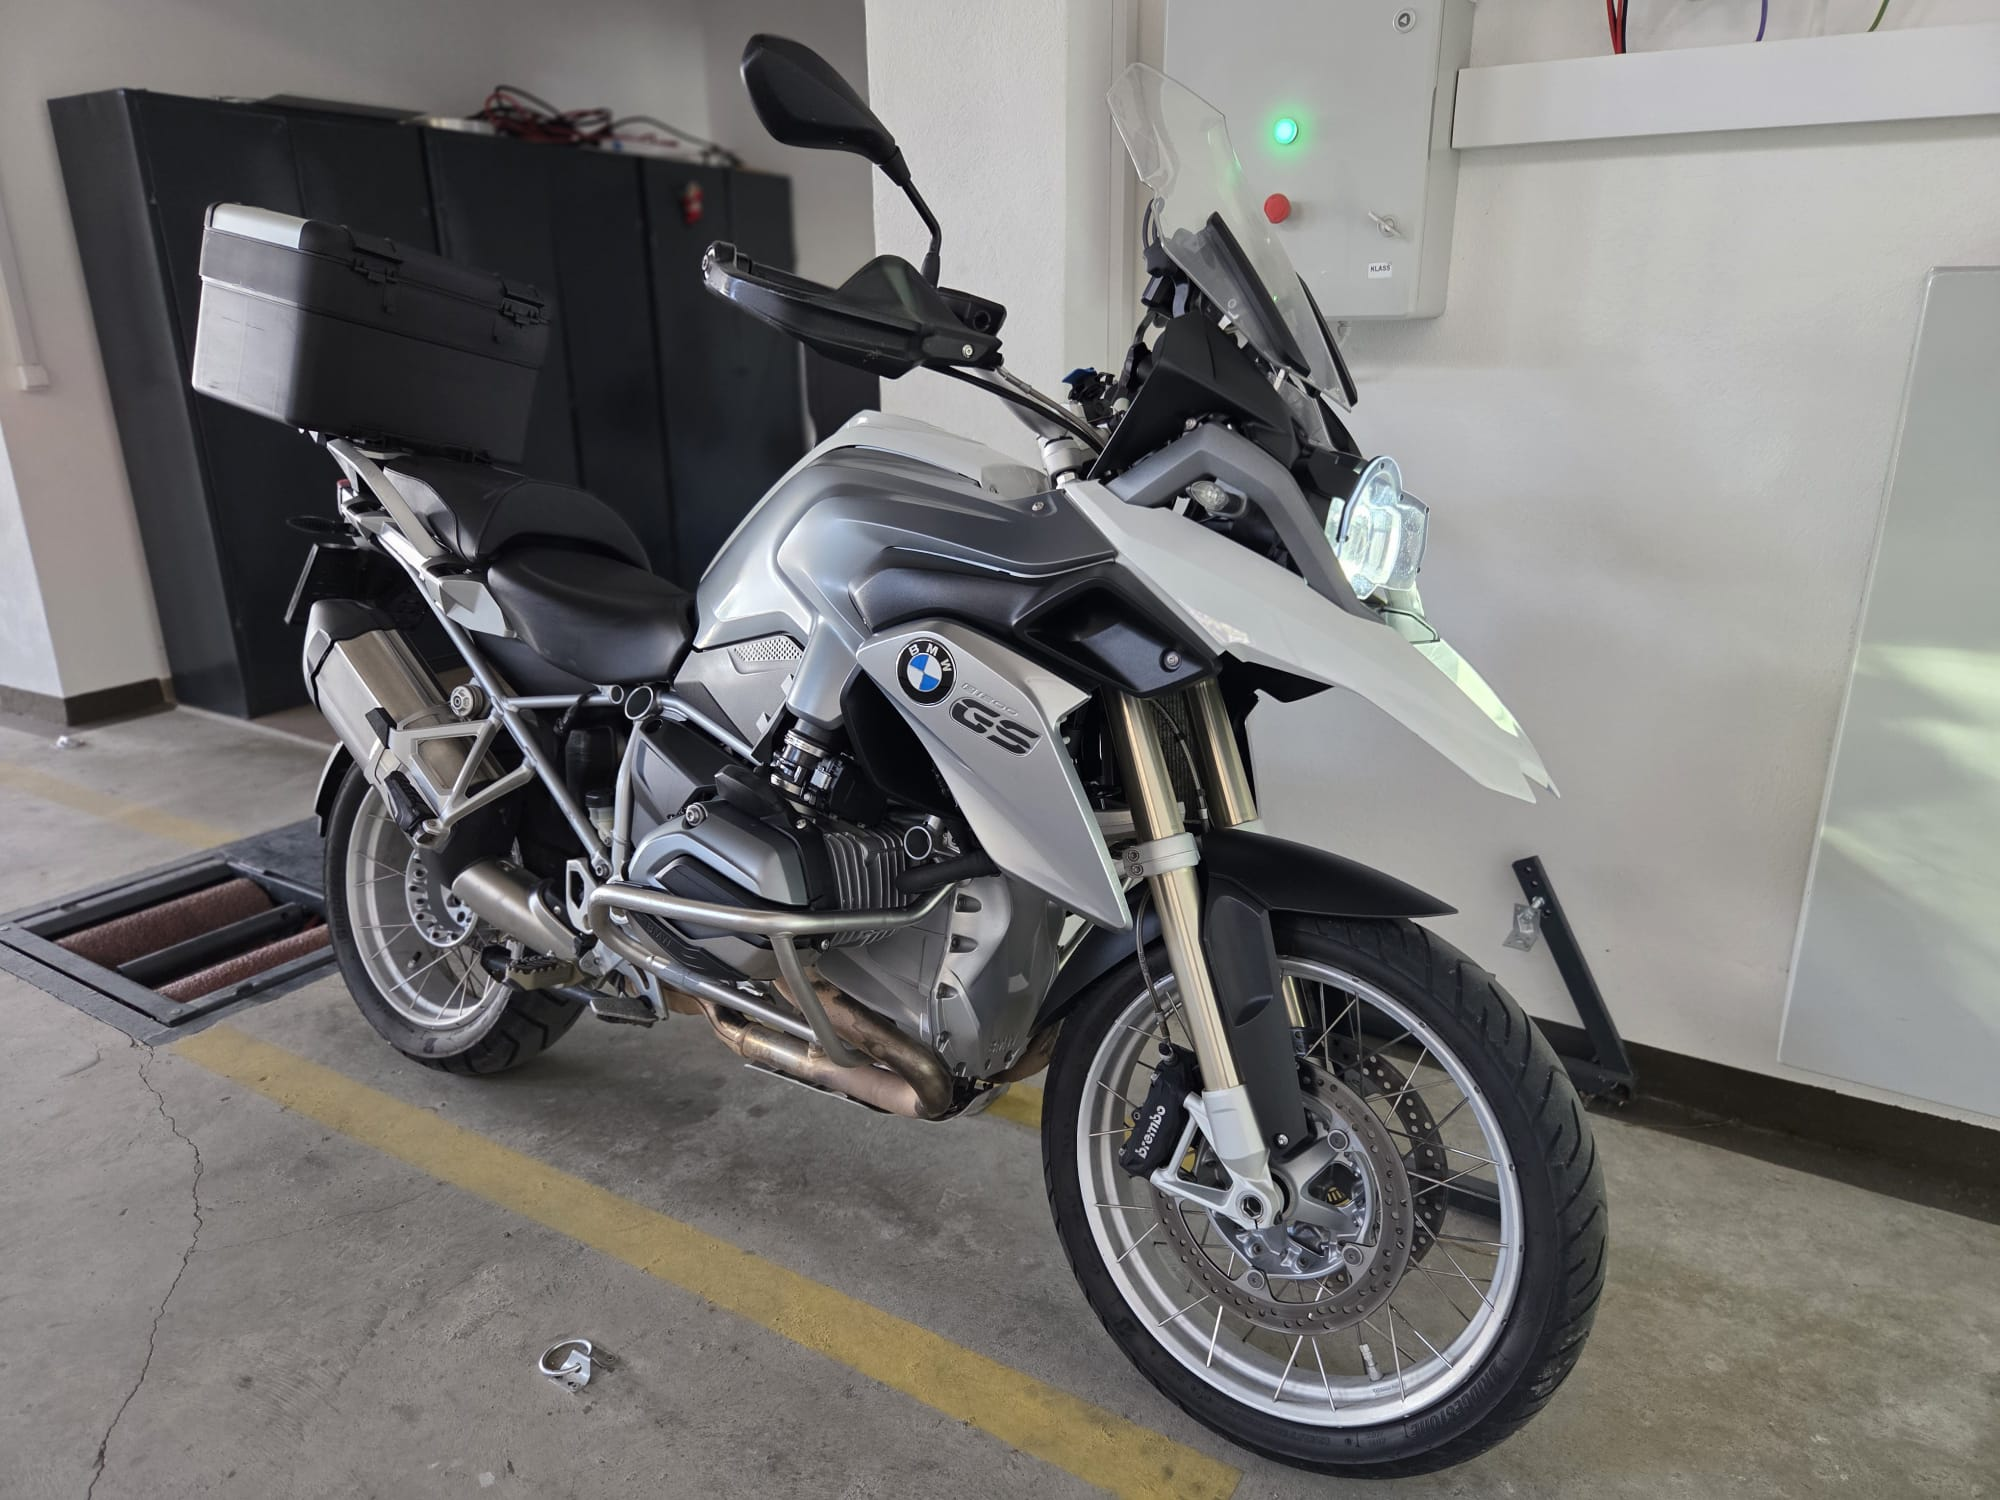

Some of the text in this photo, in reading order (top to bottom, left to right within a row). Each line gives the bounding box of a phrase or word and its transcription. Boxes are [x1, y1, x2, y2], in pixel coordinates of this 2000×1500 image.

[909, 643, 952, 672] BMW
[951, 699, 1041, 755] GS
[1134, 1105, 1166, 1159] brembo
